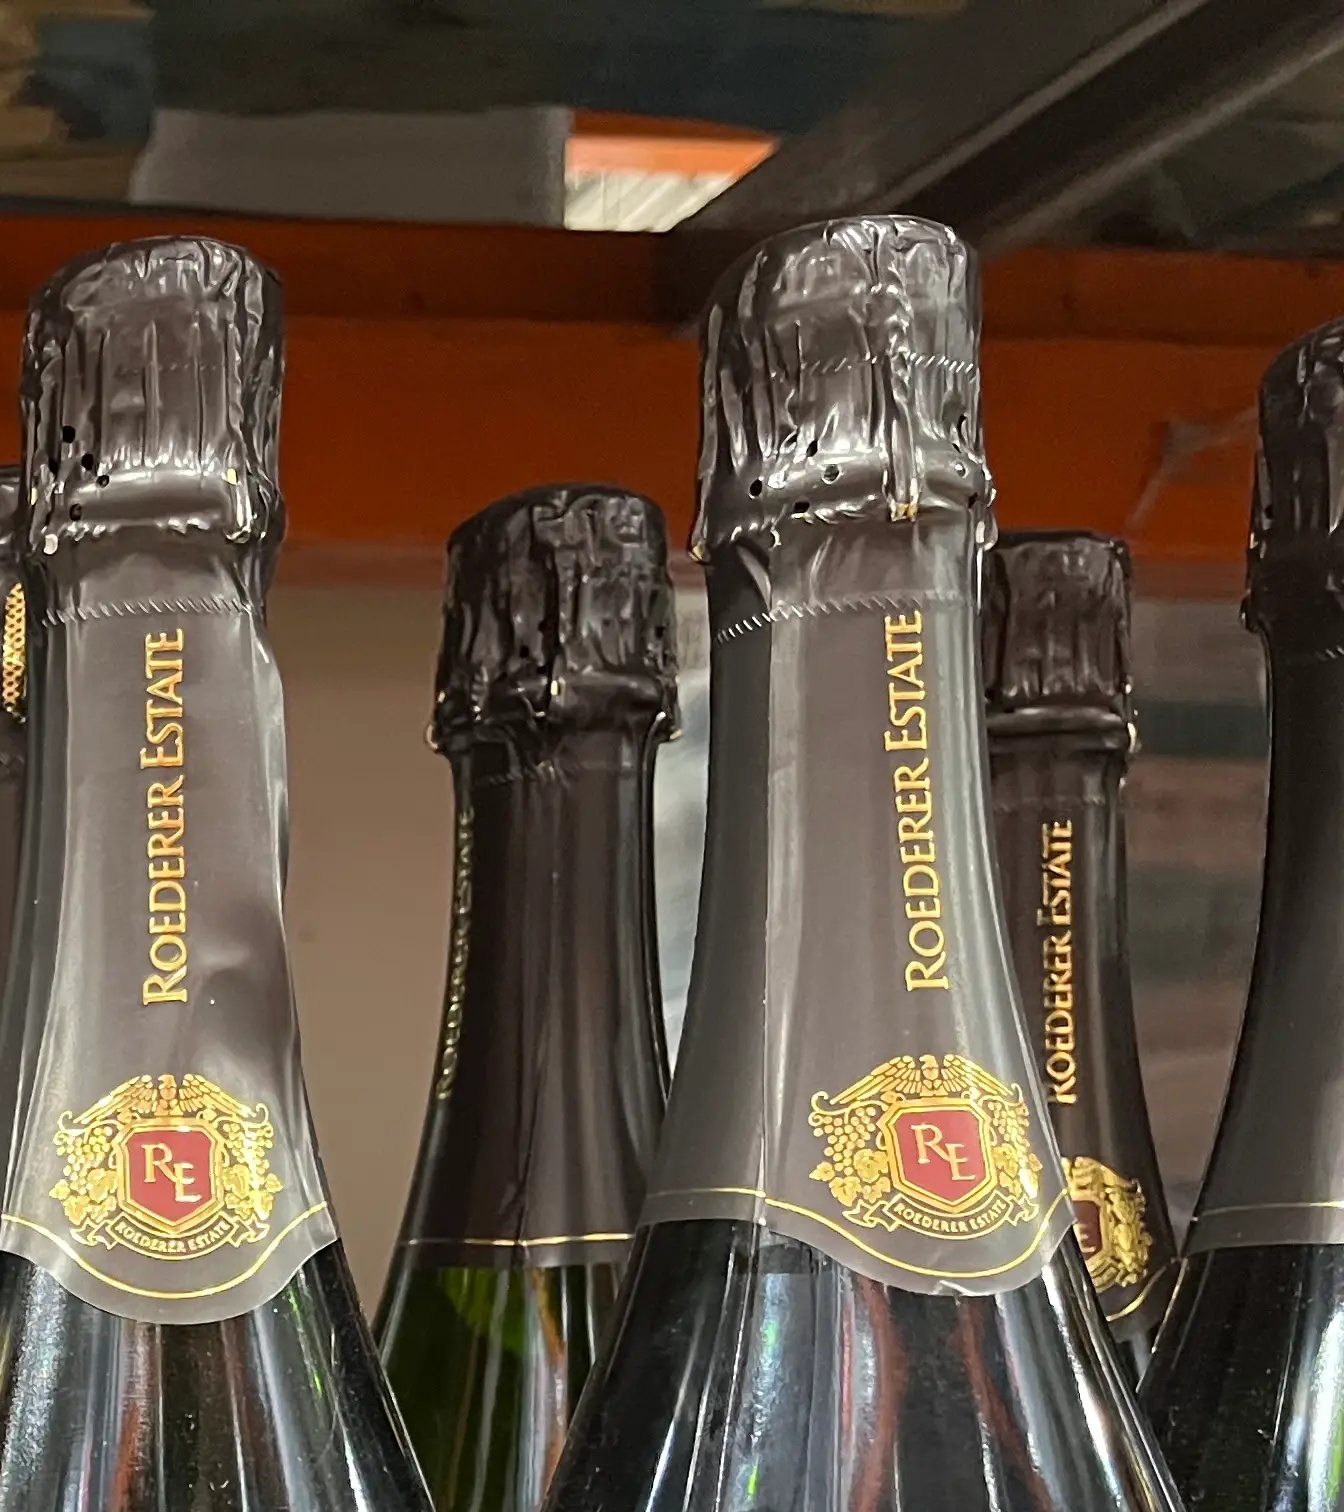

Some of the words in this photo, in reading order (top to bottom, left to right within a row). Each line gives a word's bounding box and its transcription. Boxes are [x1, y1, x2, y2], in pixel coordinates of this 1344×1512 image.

[140, 628, 184, 770] ESTATE
[885, 610, 928, 752] ESTATE
[143, 775, 189, 1007] ROEDERER
[895, 757, 950, 993] ROEDERER
